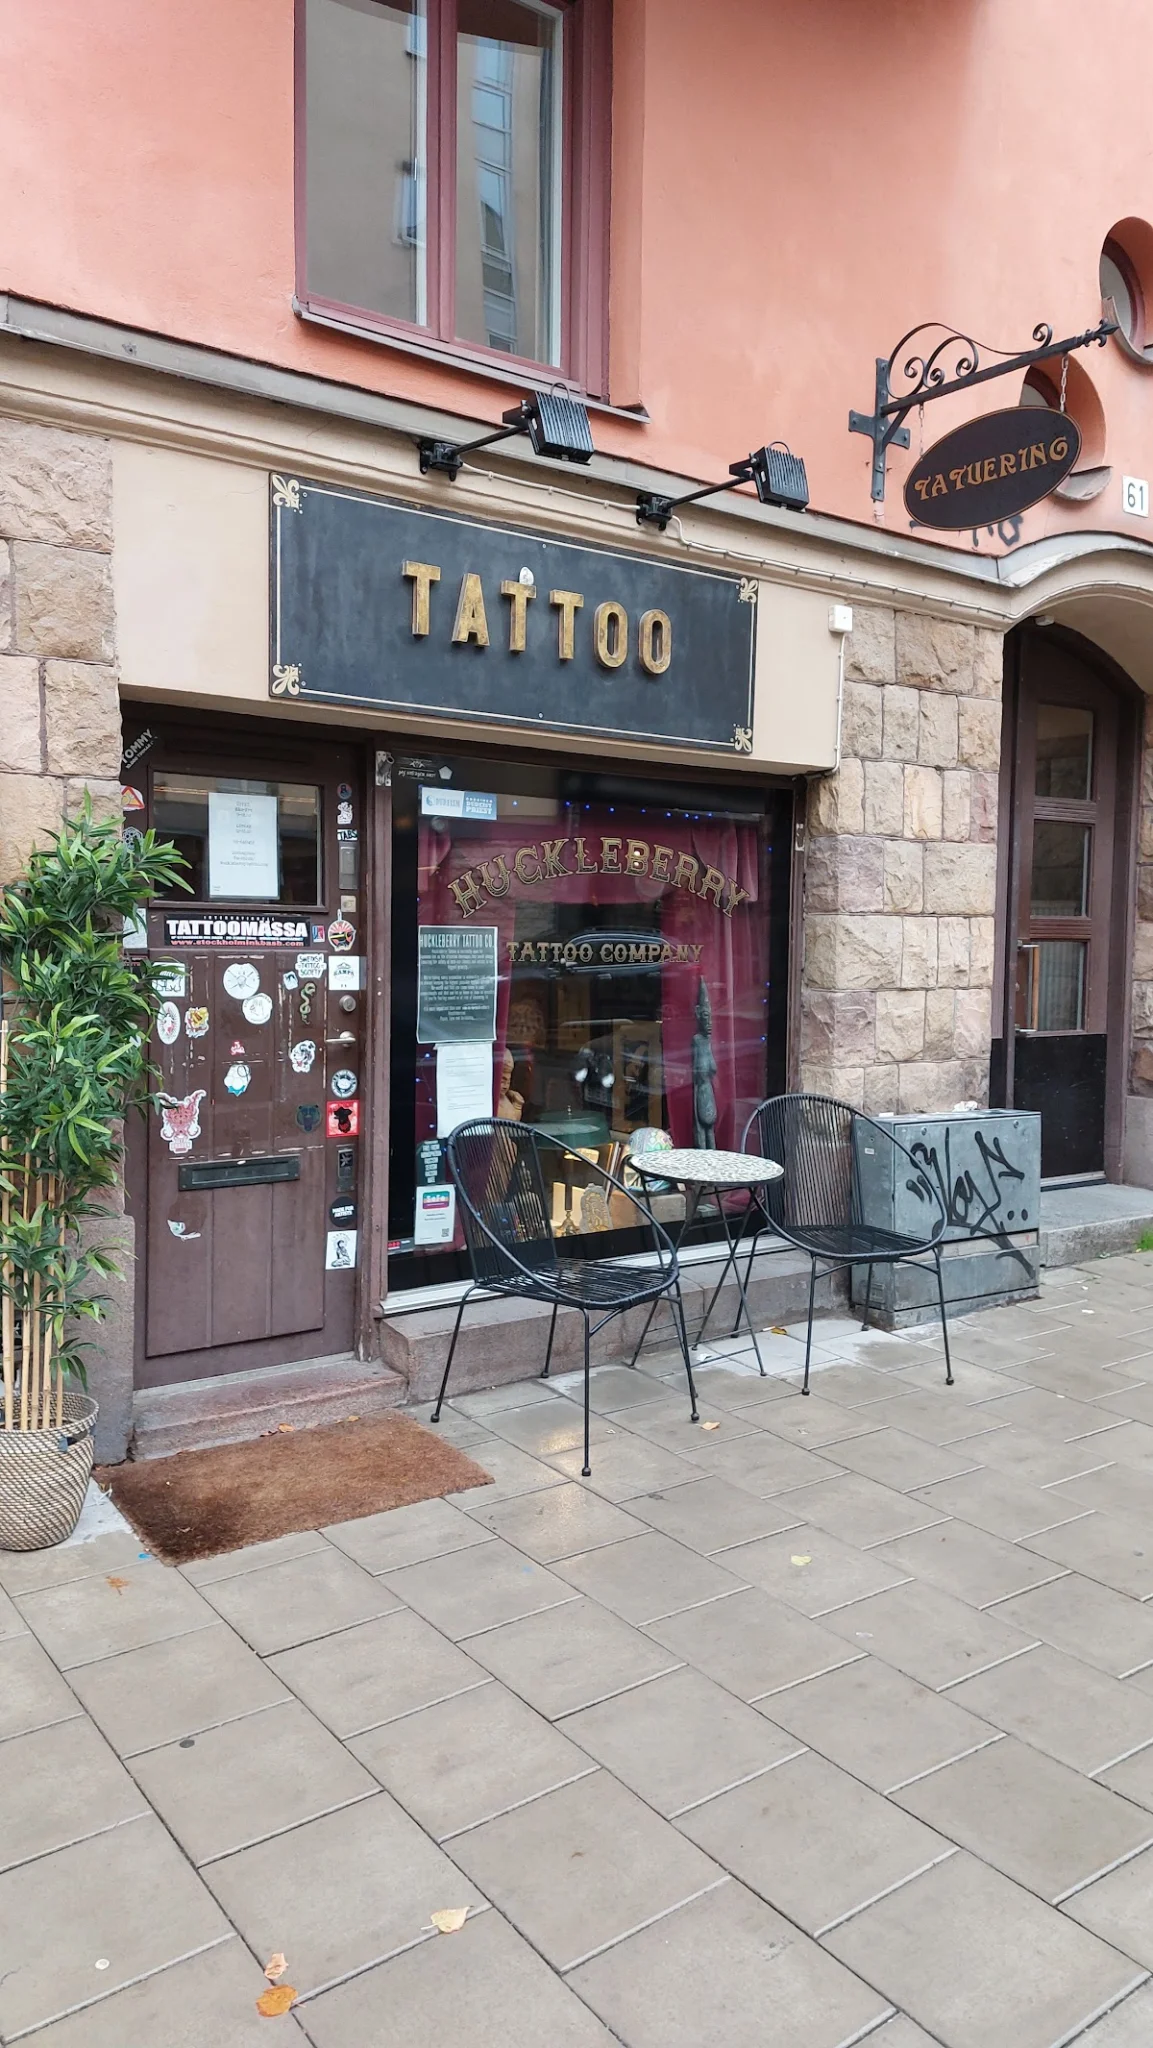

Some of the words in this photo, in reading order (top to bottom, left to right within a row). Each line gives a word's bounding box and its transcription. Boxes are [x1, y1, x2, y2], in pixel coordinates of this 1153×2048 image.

[914, 436, 1069, 501] TATUERING
[1127, 483, 1145, 511] 61
[402, 560, 672, 675] TATTOO
[447, 836, 750, 919] HUCKLEBERRY
[166, 919, 308, 938] TATTOOMÄSSA
[420, 933, 460, 948] HUCKLEBERRY
[462, 934, 483, 948] TATTOO
[171, 939, 304, 947] www.stockholminkbash.com
[506, 941, 594, 963] TATTOO
[600, 942, 704, 963] COMPANY
